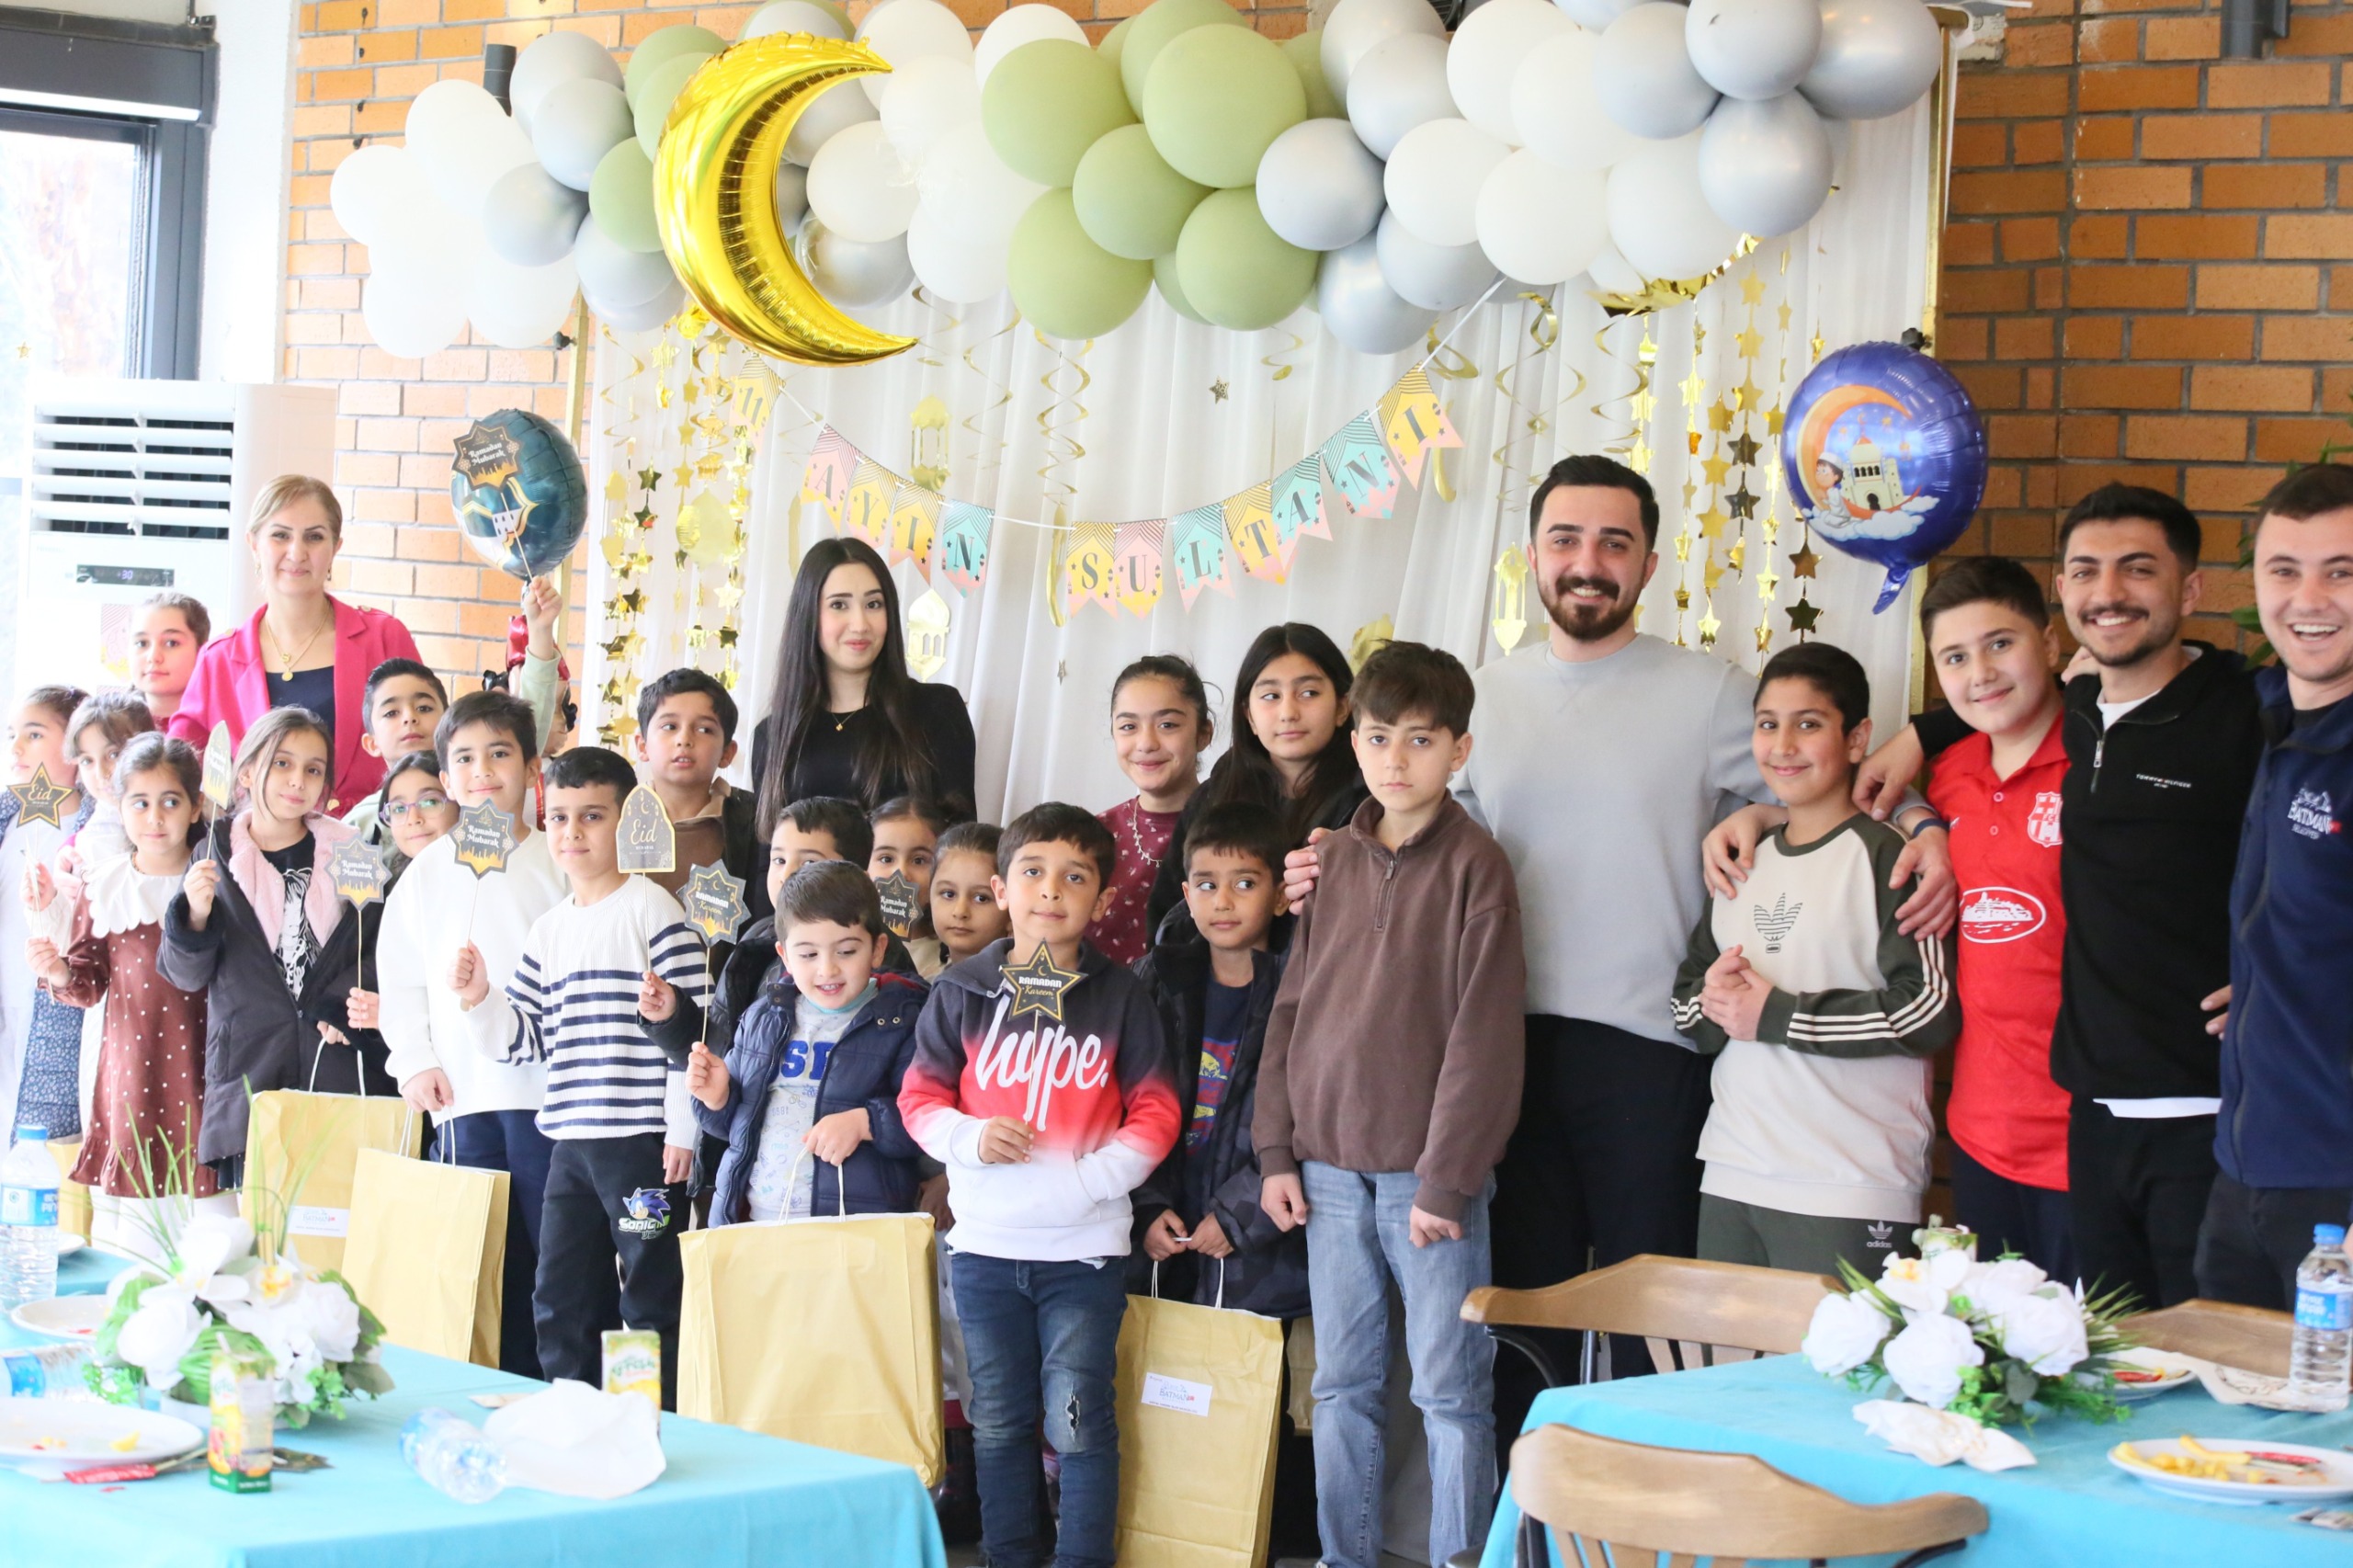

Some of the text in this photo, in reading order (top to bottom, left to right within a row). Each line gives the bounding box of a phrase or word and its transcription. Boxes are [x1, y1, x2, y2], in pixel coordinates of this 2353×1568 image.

[468, 441, 503, 459] Ramadan
[472, 449, 506, 466] Mubarak
[1081, 405, 1429, 593] SULTANI
[28, 784, 52, 801] Eid
[468, 824, 501, 838] Ramadan
[630, 819, 658, 846] Eid
[467, 834, 499, 848] Mubarak
[341, 860, 372, 870] Ramadan
[342, 868, 373, 880] Mubarak
[695, 892, 729, 908] RAMADAN
[881, 895, 907, 908] Ramadan
[881, 904, 905, 917] Mubarak
[1018, 976, 1063, 988] RAMADAN
[1025, 985, 1054, 996] Kareem
[1866, 1240, 1893, 1248] adidas
[1159, 1388, 1188, 1402] BATMAN
